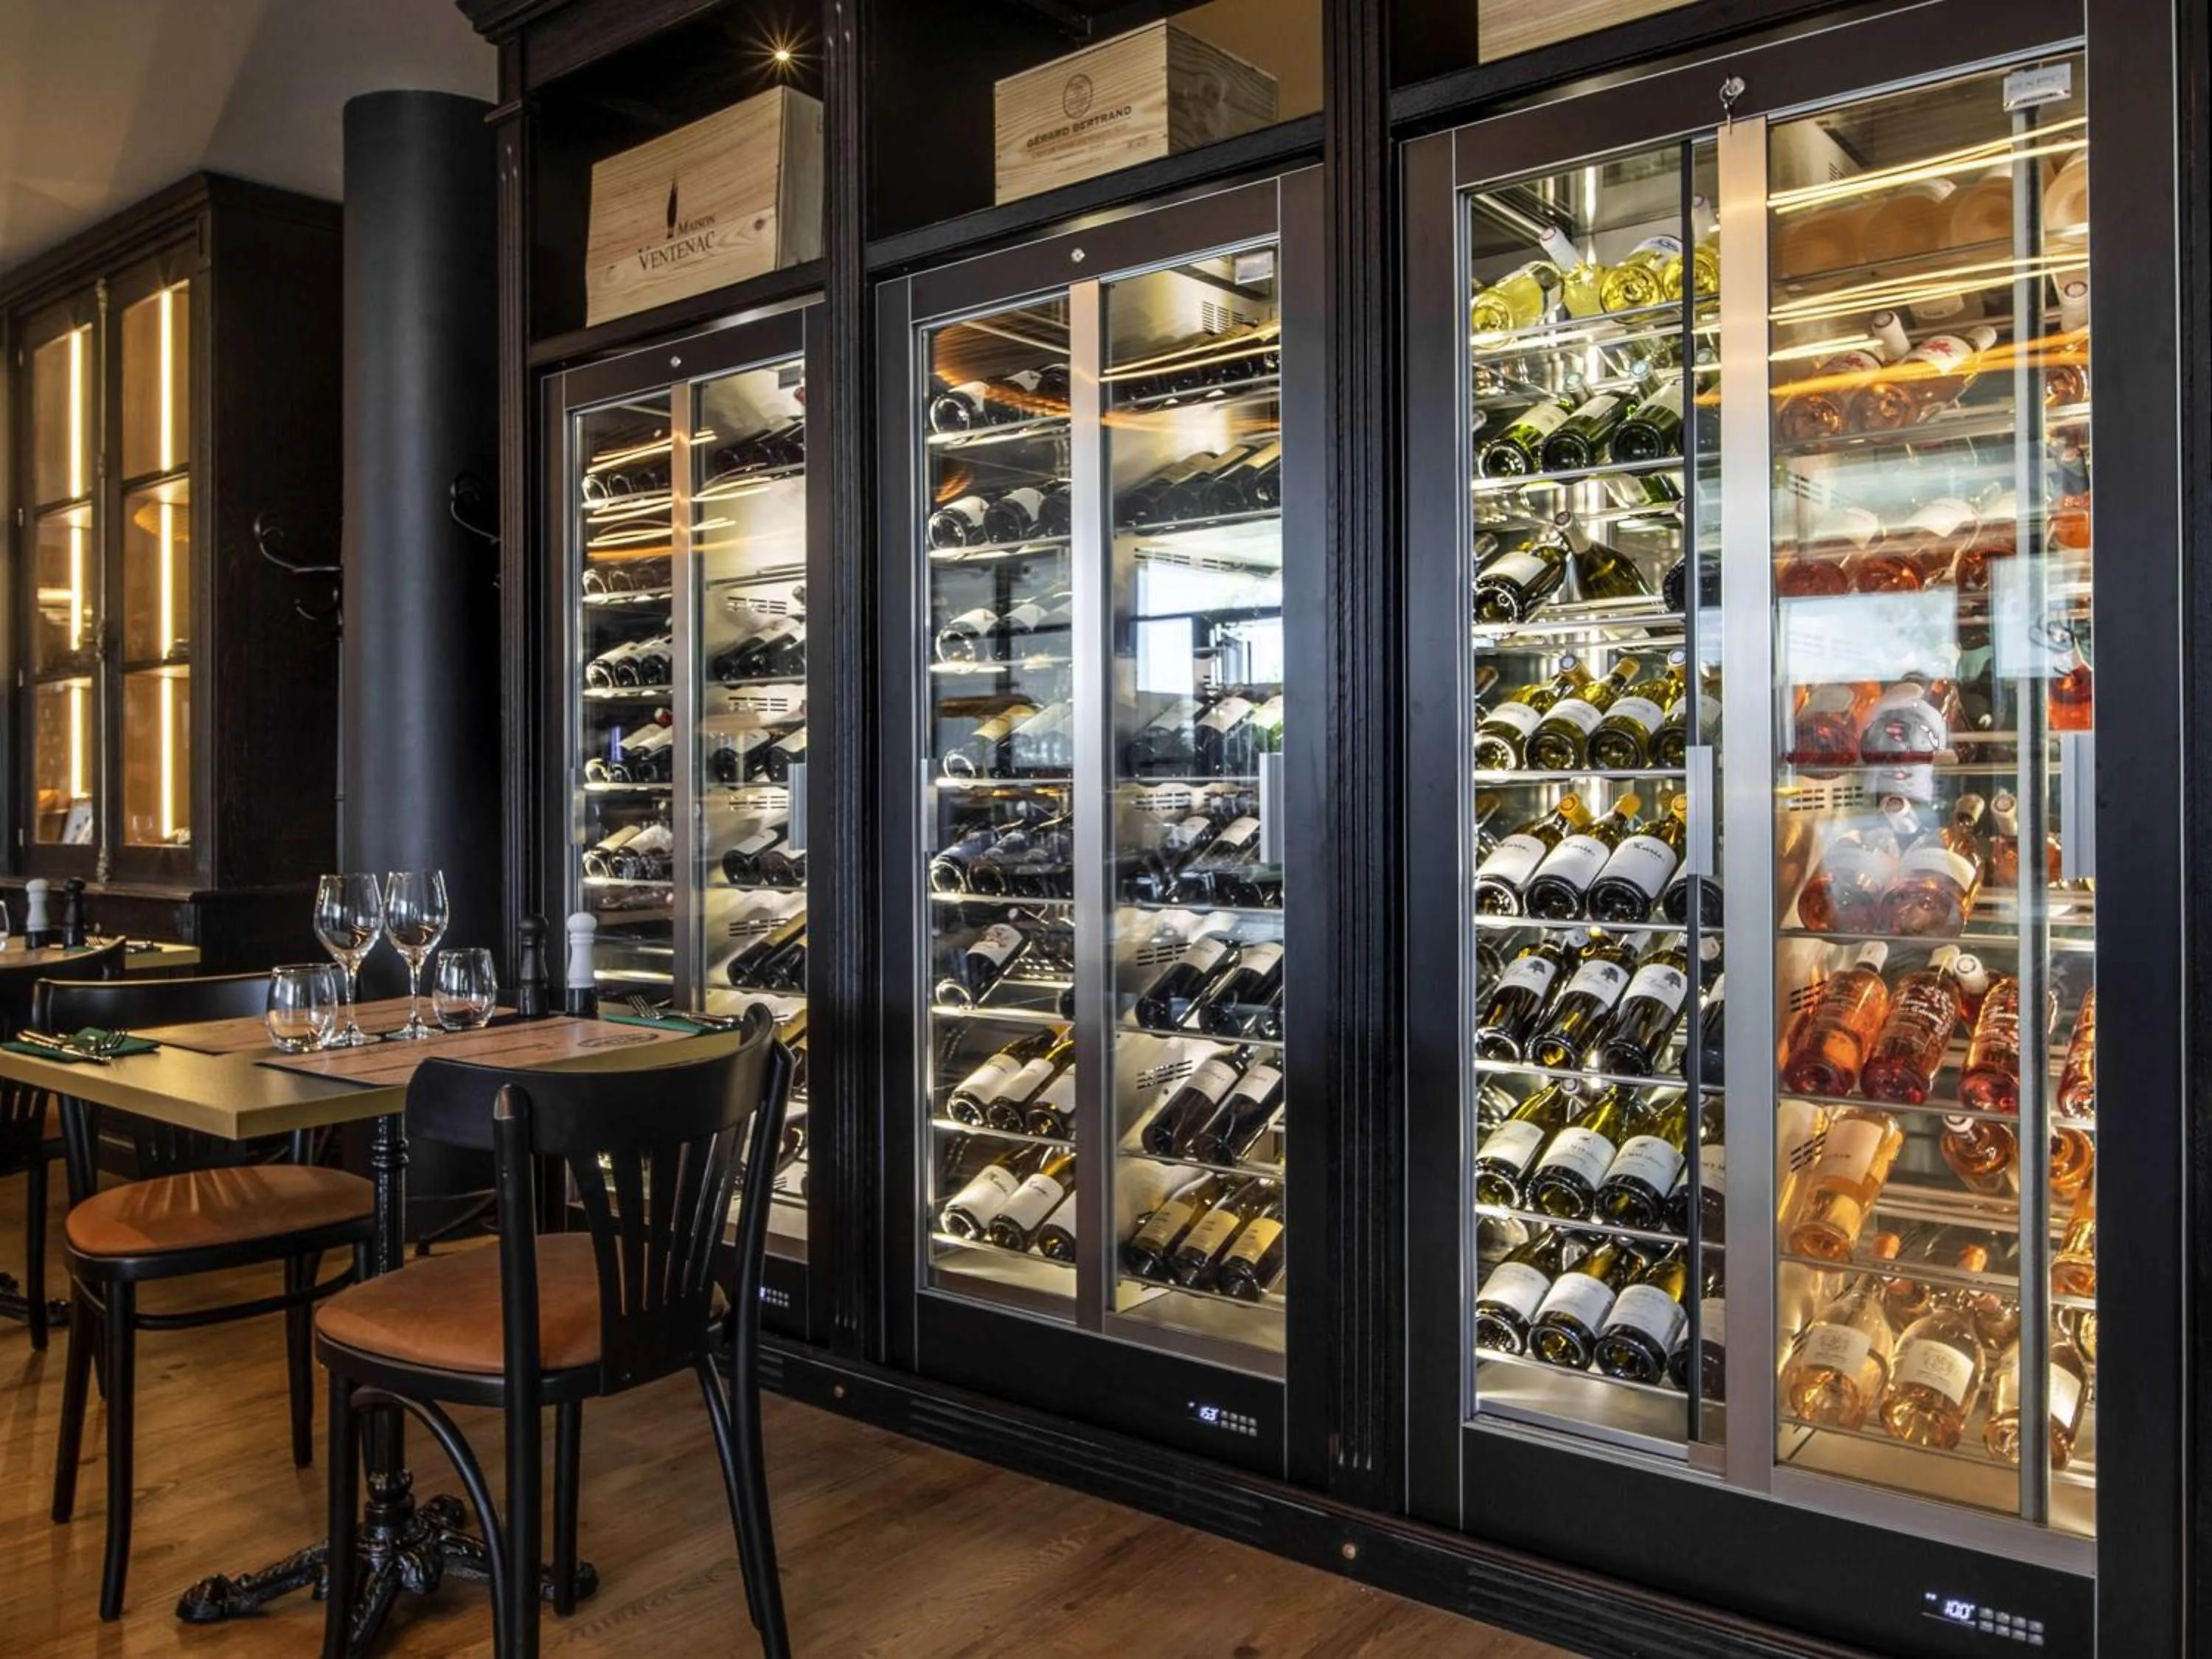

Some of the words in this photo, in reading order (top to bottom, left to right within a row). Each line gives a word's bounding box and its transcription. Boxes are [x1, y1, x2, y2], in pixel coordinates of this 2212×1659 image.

[1073, 105, 1132, 132] BERTRAND
[678, 215, 715, 234] MAISON
[639, 230, 715, 271] VENTENAC
